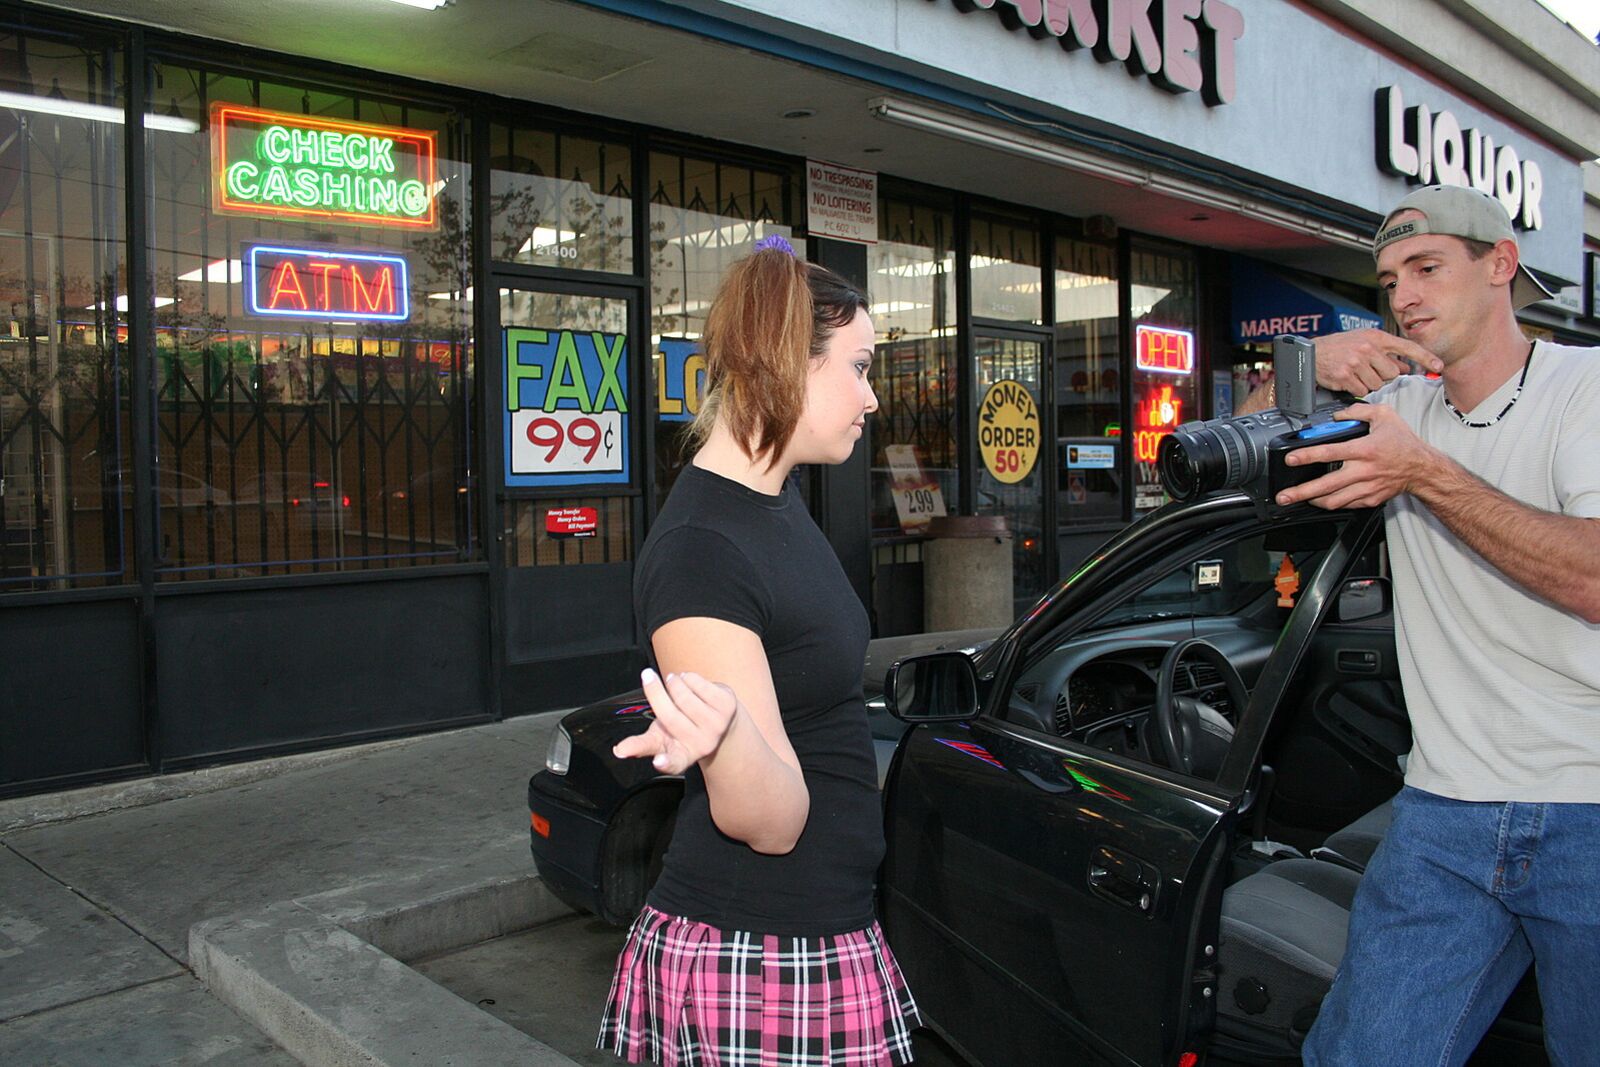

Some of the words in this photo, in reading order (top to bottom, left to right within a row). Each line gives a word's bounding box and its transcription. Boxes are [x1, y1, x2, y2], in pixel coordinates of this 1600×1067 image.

[264, 126, 395, 173] CHECK
[1387, 83, 1542, 231] LIQUOR
[228, 161, 428, 216] CASHING
[810, 167, 822, 181] NO
[823, 170, 874, 191] TRESPASSING
[813, 192, 826, 206] NO
[828, 195, 872, 214] LOITERING
[536, 244, 578, 260] 21400
[269, 262, 394, 313] ATM
[1241, 313, 1323, 337] MARKET
[1138, 329, 1188, 371] OPEN
[506, 327, 629, 414] FAX
[982, 384, 1036, 424] MONEY
[981, 426, 1035, 448] ORDER
[904, 489, 934, 513] 299
